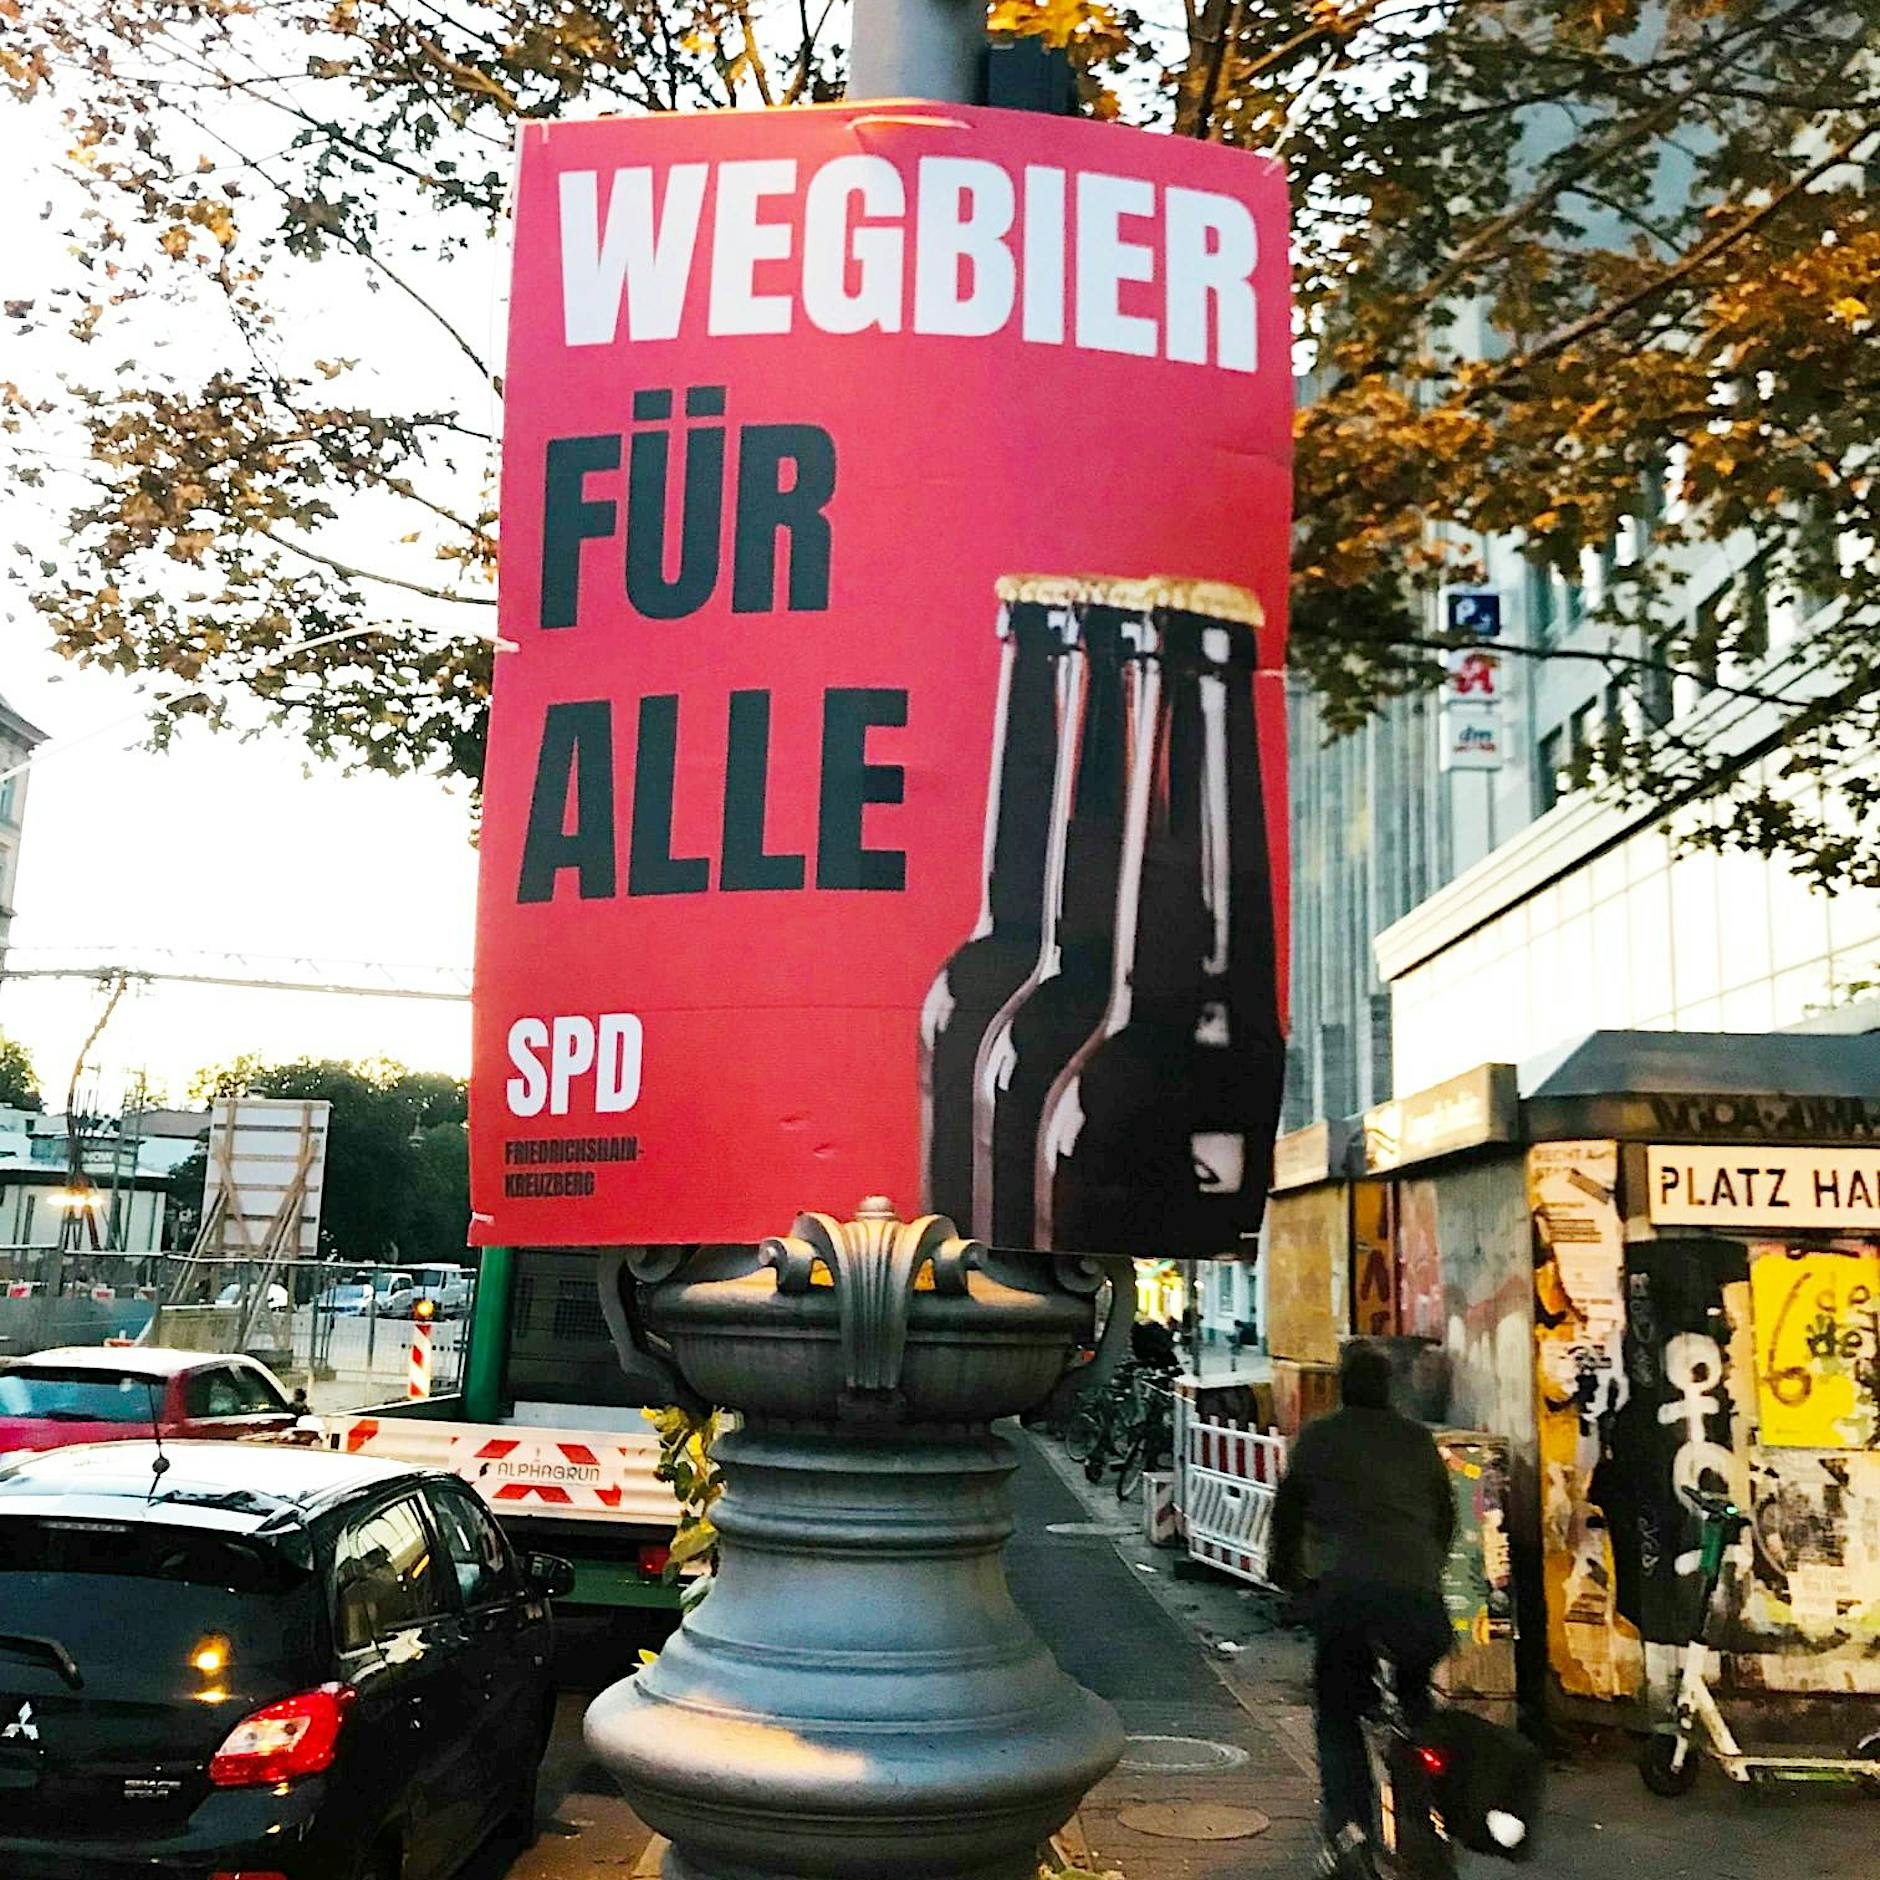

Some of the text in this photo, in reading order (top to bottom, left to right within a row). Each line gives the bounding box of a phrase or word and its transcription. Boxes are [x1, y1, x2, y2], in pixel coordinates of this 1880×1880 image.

[558, 154, 1258, 373] WEGBIER
[539, 385, 837, 630] FÜR
[1459, 726, 1492, 742] dm
[517, 687, 908, 903] ALLE
[506, 1013, 643, 1117] SPD
[504, 1171, 595, 1197] KREUZBERG
[505, 1137, 644, 1165] FRIEDRICHSHAIN-
[1661, 1166, 1880, 1209] PLATZ HA
